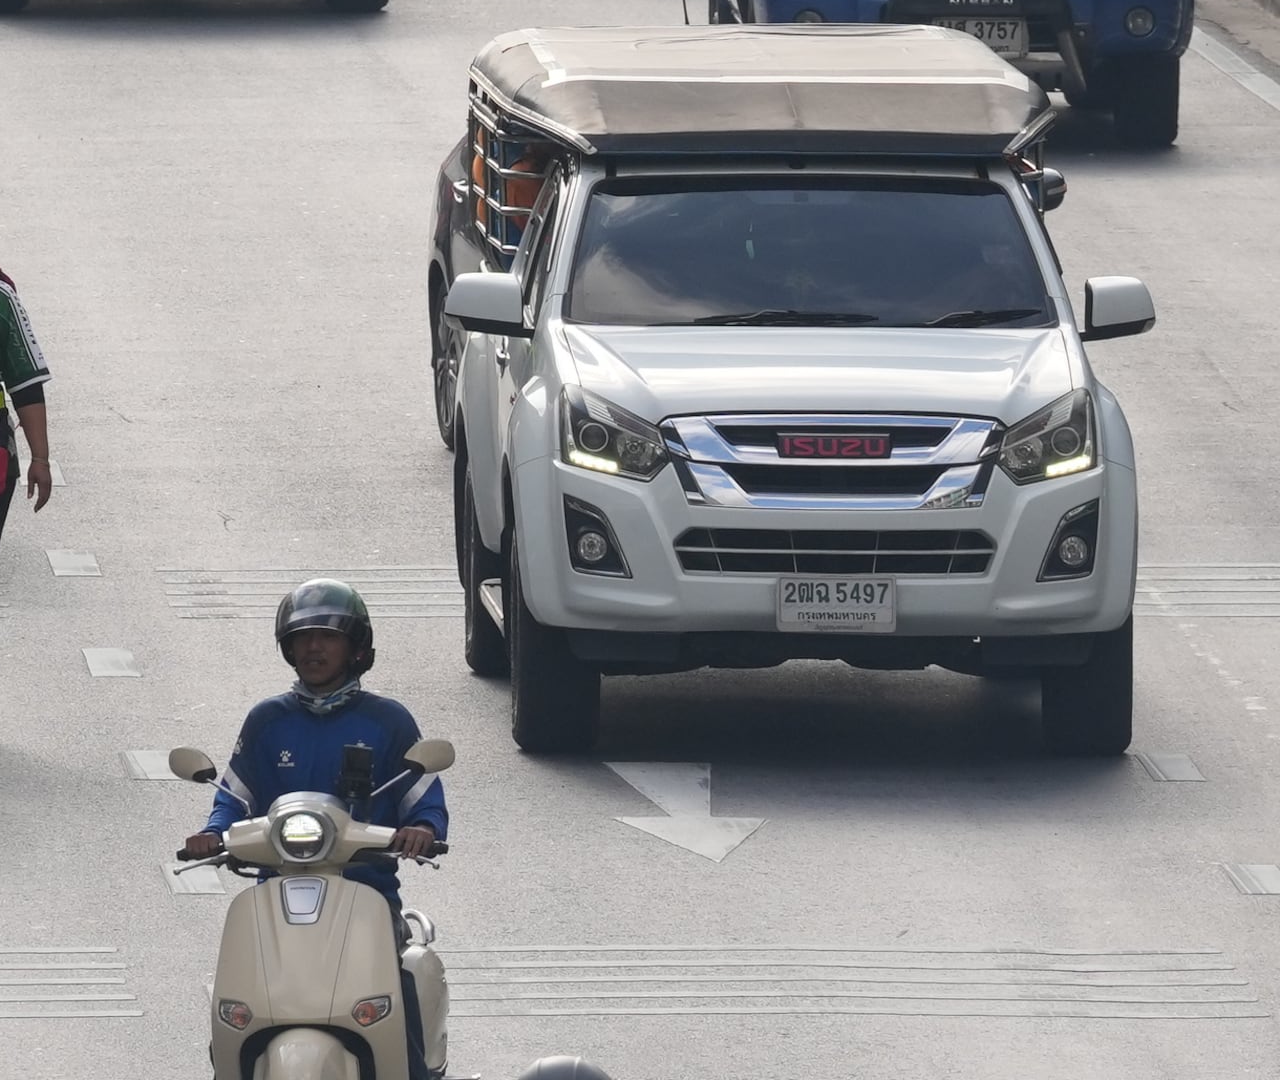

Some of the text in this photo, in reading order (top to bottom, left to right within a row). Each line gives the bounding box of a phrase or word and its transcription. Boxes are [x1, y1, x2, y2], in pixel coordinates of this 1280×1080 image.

[974, 22, 1020, 40] 3757
[783, 438, 885, 456] ISUZU
[835, 582, 890, 605] 5497
